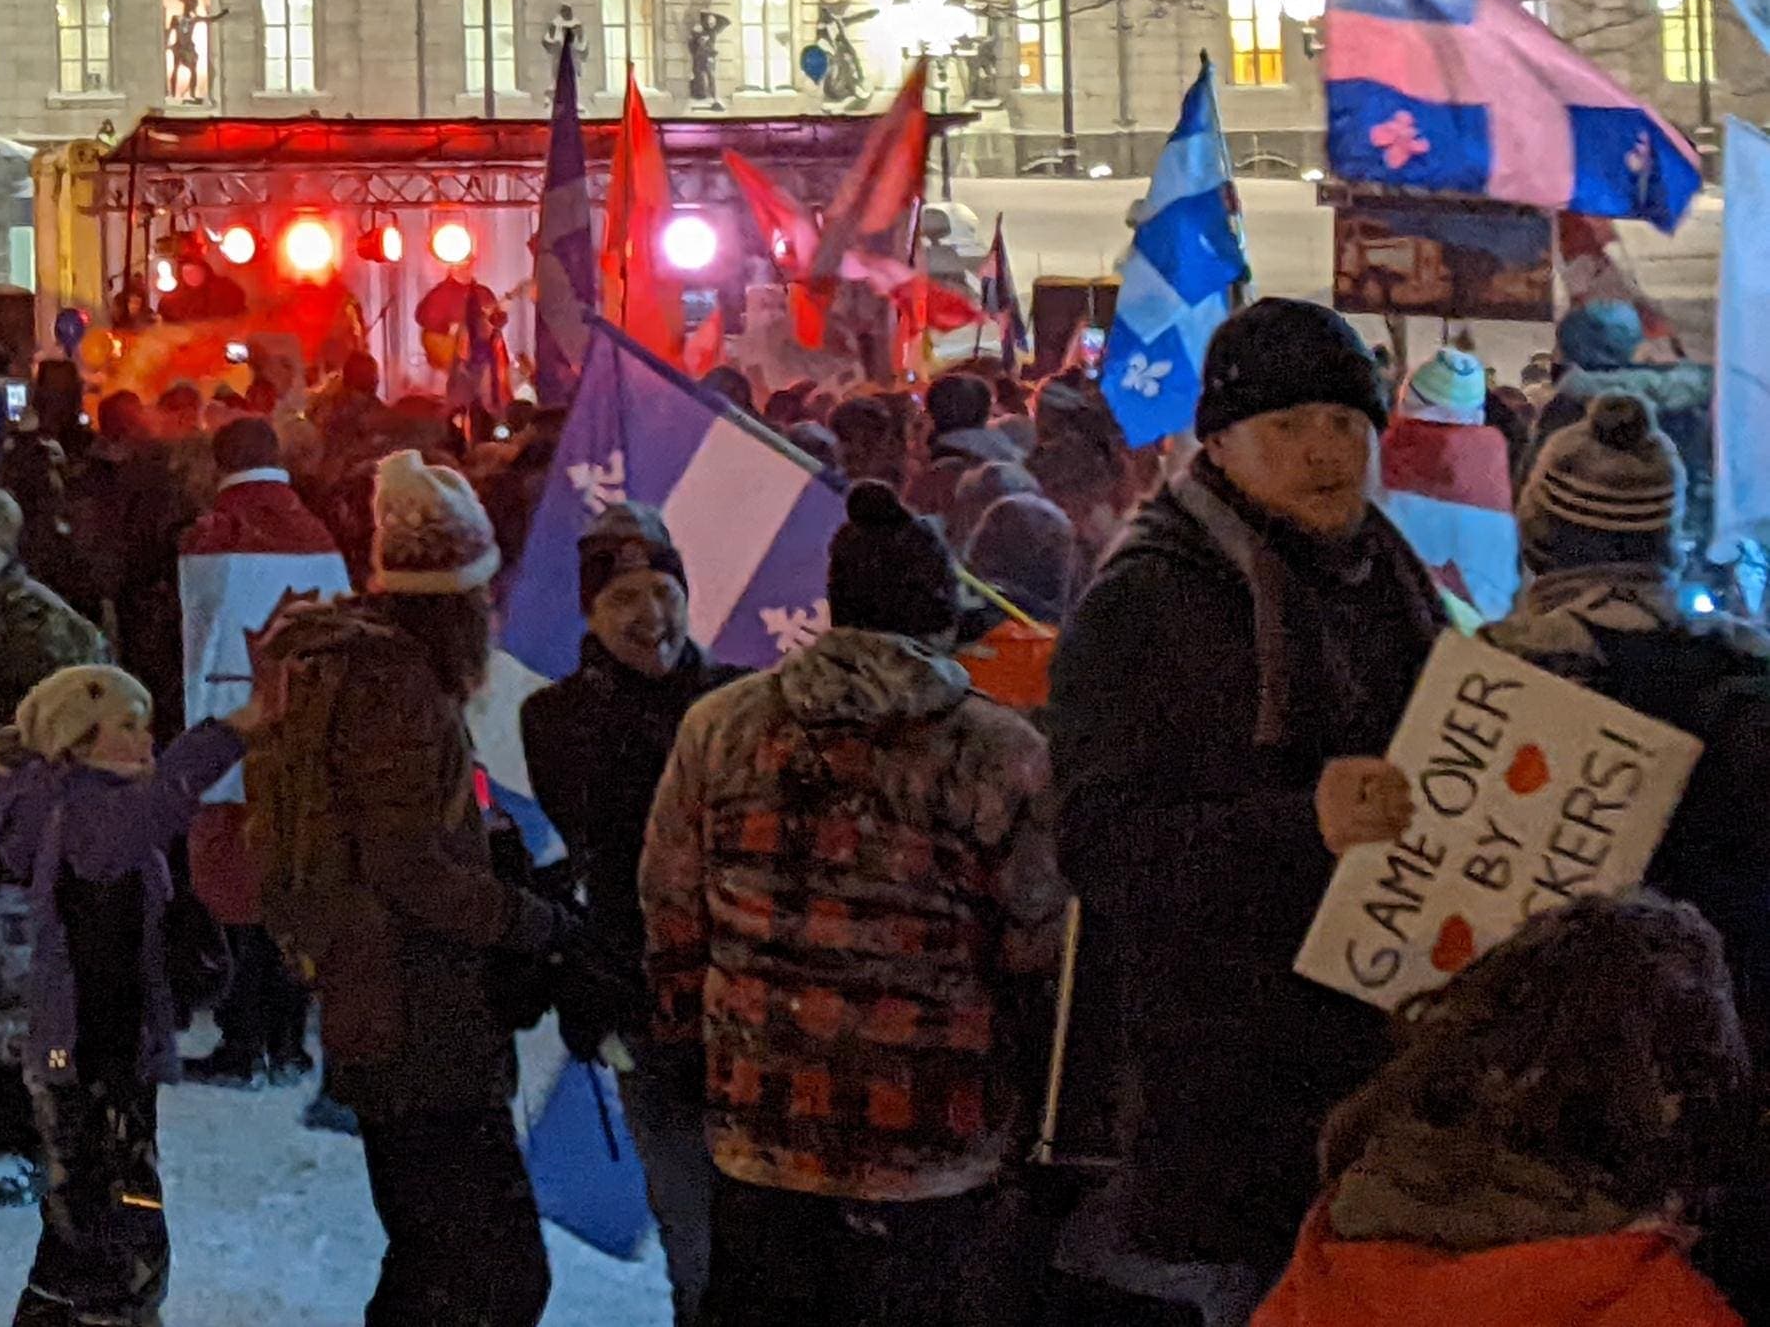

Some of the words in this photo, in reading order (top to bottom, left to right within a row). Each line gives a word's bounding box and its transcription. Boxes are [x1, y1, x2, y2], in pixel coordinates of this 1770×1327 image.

[1345, 832, 1447, 988] GAME
[1419, 672, 1525, 817] OVER
[1463, 815, 1523, 892] BY
